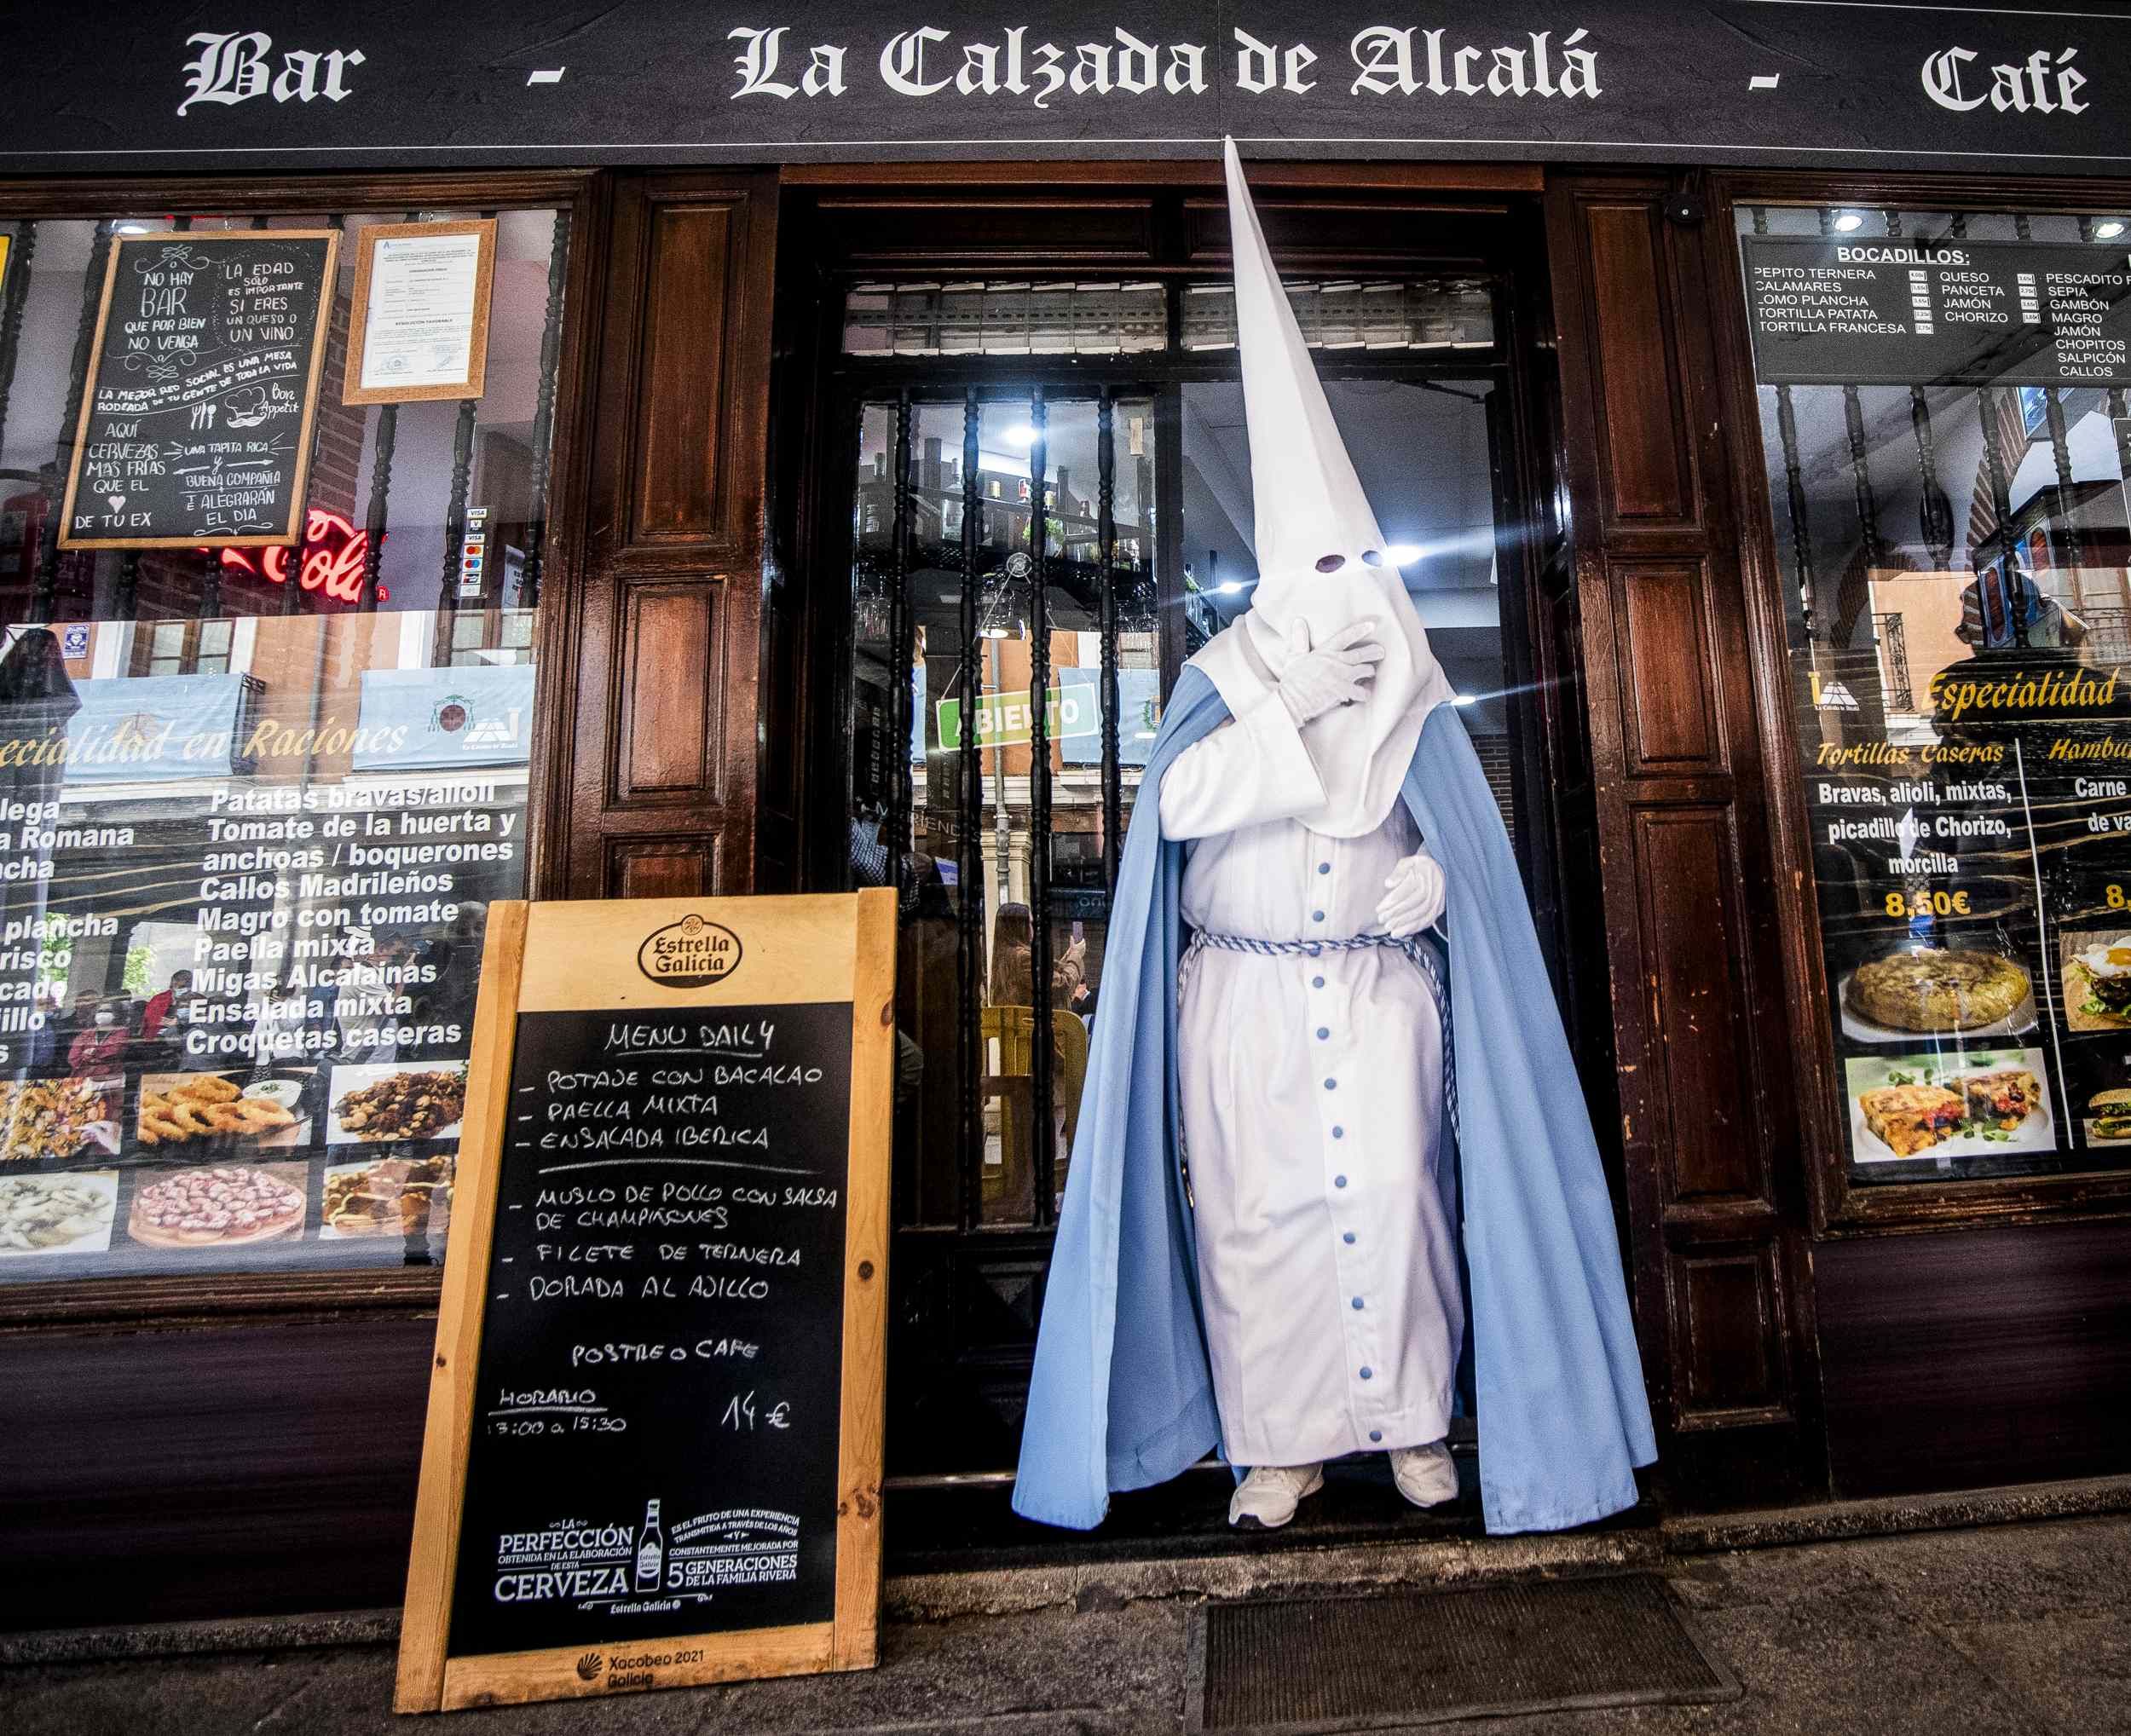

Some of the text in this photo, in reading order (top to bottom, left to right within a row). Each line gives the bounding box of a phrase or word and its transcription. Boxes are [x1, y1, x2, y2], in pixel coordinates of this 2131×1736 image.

[177, 31, 367, 117] Bar
[727, 26, 1603, 108] La Calzada de Alcalá
[1921, 46, 2090, 115] Café
[1837, 245, 1971, 264] BOCADILLOS:
[144, 271, 193, 286] NO HAY
[226, 262, 294, 280] LA EDAD
[1809, 268, 1877, 280] TERNERA
[1939, 271, 1990, 283] QUESO
[2046, 274, 2122, 285] PESCADITO
[245, 281, 304, 295] IMPORTANTE
[1755, 280, 1842, 292] CALAMARES
[1942, 285, 2005, 297] PANCETA
[2048, 286, 2088, 297] SEPIA
[141, 286, 187, 318] BAR
[230, 297, 288, 314] SI ERES
[1802, 295, 1869, 306] PLANCHA
[1943, 297, 1991, 309] JAMÓN
[2050, 298, 2110, 311] GAMBÓN
[226, 314, 285, 326] UN QUESO
[1759, 308, 1878, 320] TORTILLA PATATA
[1945, 311, 2008, 323] CHORIZO
[2052, 312, 2103, 324] MAGRO
[124, 317, 206, 334] QUE POR BIEN
[230, 326, 294, 343] UN VINO
[1760, 321, 1827, 332] TORTILLA
[1830, 322, 1907, 334] FRANCESA
[2053, 325, 2101, 337] JAMÓN
[128, 335, 199, 350] NO VENGA
[2055, 339, 2126, 350] CHOPITOS
[2058, 351, 2126, 364] SALPICÓN
[98, 351, 292, 401] LA MEJOR SOCIAL MESA
[2059, 366, 2113, 377] CALLOS
[97, 361, 297, 412] RODEADA GENTE VIDA
[104, 418, 142, 438] AQUÍ
[89, 442, 159, 459] CERVEZAS
[185, 441, 269, 455] UNA TAPITA RICA
[127, 459, 166, 476] FRÍAS
[93, 479, 149, 493] QUE EL
[186, 474, 223, 487] BUENA
[200, 487, 275, 510] ALEGRARÁN
[75, 511, 152, 529] DE TU EX
[206, 511, 228, 525] EL
[1920, 667, 2121, 720] Especialidad
[241, 718, 407, 758] Raciones
[1816, 741, 2005, 766] Tortillas Caseras
[1818, 780, 2012, 807] Bravas, alioli, mixtas,
[2075, 777, 2127, 798] Carne
[211, 788, 319, 814] Patatas
[207, 810, 517, 841] Tomate de la huerta y
[1935, 815, 2012, 840] Chorizo,
[2088, 812, 2110, 832] de
[20, 825, 135, 848] Romana
[202, 841, 514, 873] anchoas boquerones
[1888, 852, 1959, 874] morcilla
[199, 870, 453, 901] Callos Madrileños
[1885, 891, 1972, 919] 8,50€
[197, 900, 459, 936] Magro con tomate
[3, 914, 119, 945] plancha
[193, 932, 376, 962] Paella mixta
[652, 935, 730, 955] Estrella
[655, 954, 726, 972] Galicia
[191, 966, 279, 997] Migas
[189, 992, 413, 1023] Ensalada mixta
[186, 1023, 462, 1058] Croquetas caseras
[604, 1023, 687, 1052] MENU
[547, 1067, 704, 1092] POTAJE CON
[643, 1094, 719, 1116] MIXTA
[676, 1126, 769, 1146] IBERICA
[535, 1187, 615, 1208] MUSLO
[626, 1185, 653, 1203] DE
[732, 1187, 777, 1207] CON
[536, 1212, 563, 1231] DE
[659, 1244, 687, 1261] DE
[699, 1243, 801, 1266] TERNERA
[529, 1277, 624, 1302] DORADA
[641, 1276, 677, 1299] AL
[572, 1338, 759, 1367] POSTRE CAFE
[499, 1388, 596, 1405] HORARIO
[721, 1390, 791, 1432] 14 €
[692, 1509, 800, 1527] FRUTO EXPERIENCIA
[499, 1522, 634, 1554] PERFECCIÓN
[673, 1523, 721, 1544] TRANSMITIDA
[498, 1547, 632, 1565] OBTENIDA ELABORACIÓN
[669, 1541, 782, 1556] CONSTANTEMENTE MEJORADA
[667, 1562, 684, 1589] 5
[685, 1554, 798, 1575] GENERACIONES
[716, 1568, 797, 1584] FAMILIA RIVERA
[494, 1567, 629, 1602] CERVEZA
[609, 1649, 704, 1671] Xacobeo 2021
